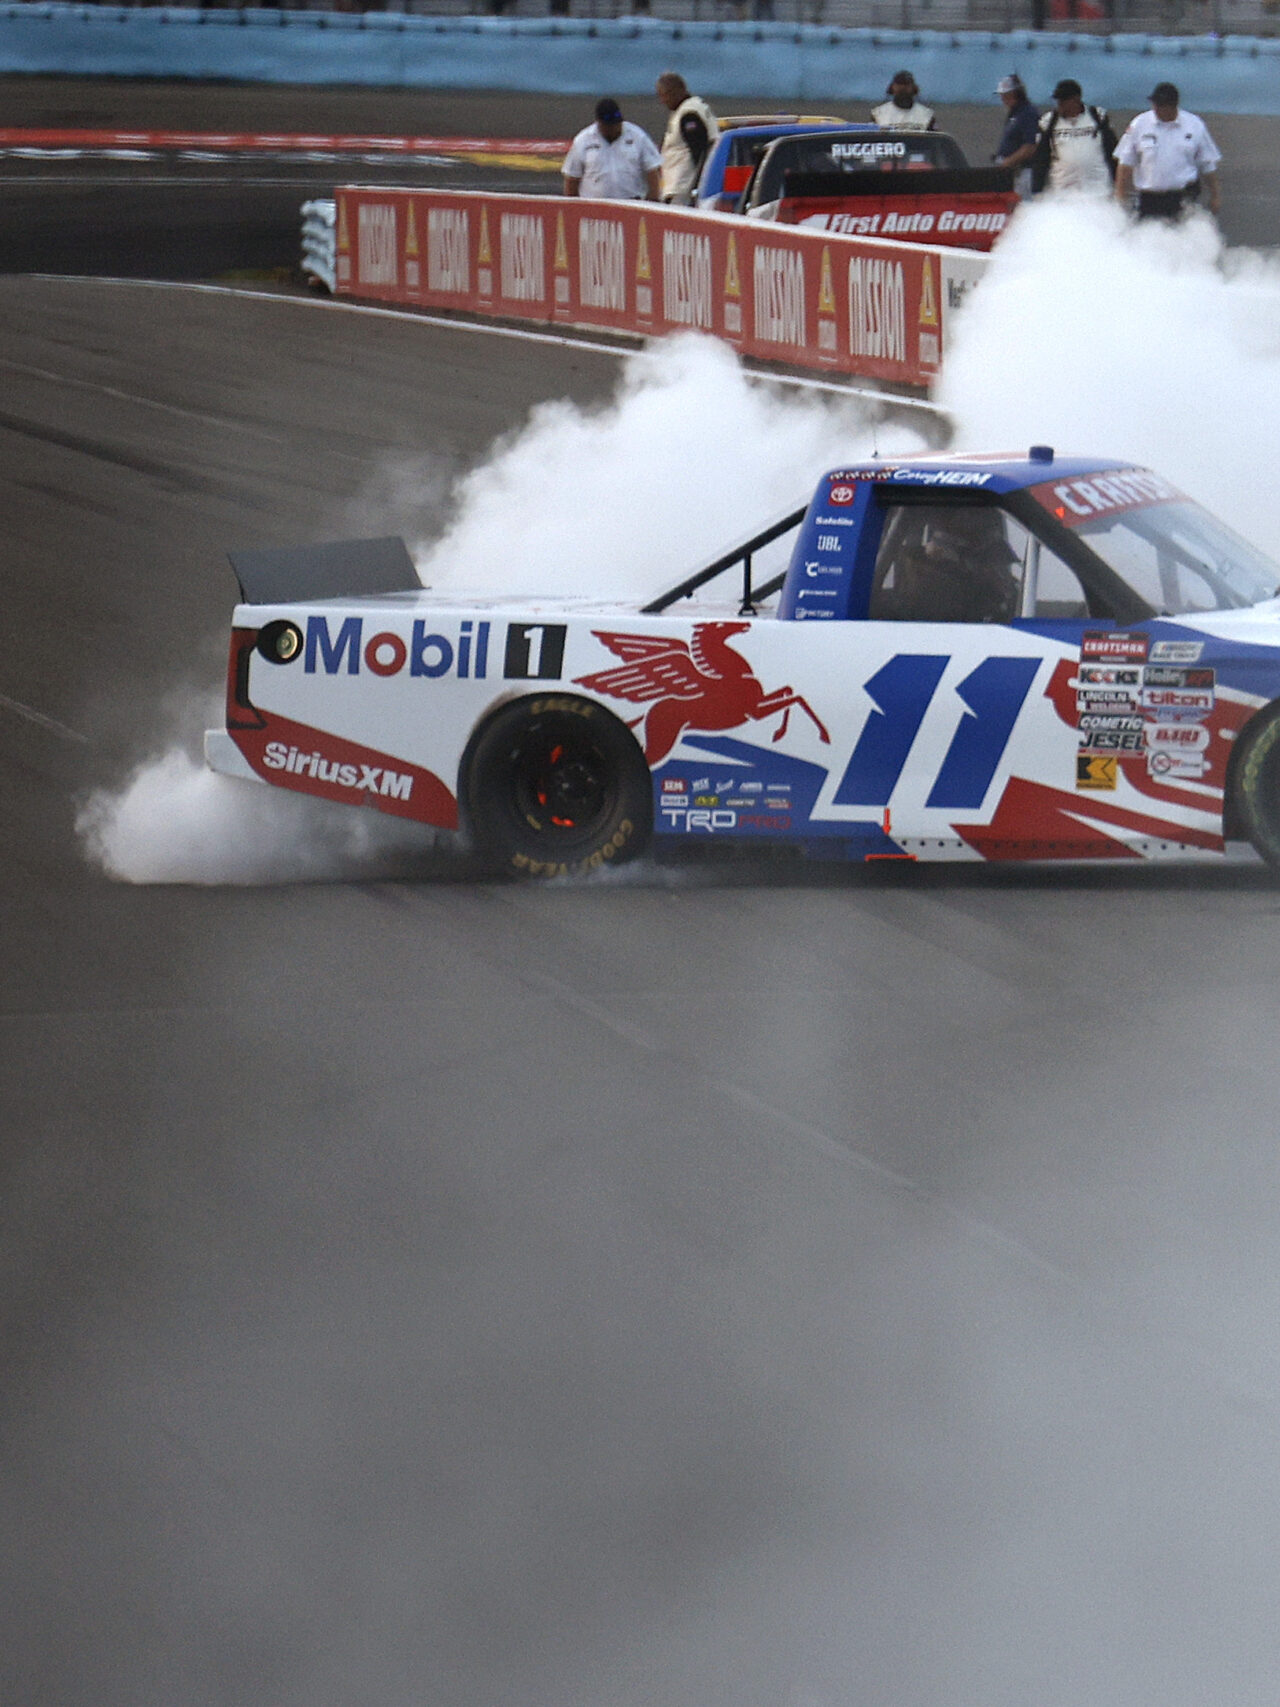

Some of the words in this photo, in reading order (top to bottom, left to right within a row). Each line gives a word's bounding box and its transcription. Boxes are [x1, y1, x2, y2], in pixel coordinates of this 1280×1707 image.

[831, 142, 906, 157] RUGGIERO
[830, 213, 882, 232] First
[882, 212, 935, 232] Auto
[938, 211, 1007, 232] Group
[304, 615, 491, 679] Mobil
[1083, 640, 1145, 653] CRAFTSMAN
[1148, 691, 1210, 707] tilton
[831, 652, 1045, 810] 11
[1079, 716, 1145, 729] COMETIC
[1079, 731, 1146, 750] JESEL
[262, 741, 414, 801] SiriusXM
[661, 809, 736, 833] TRD
